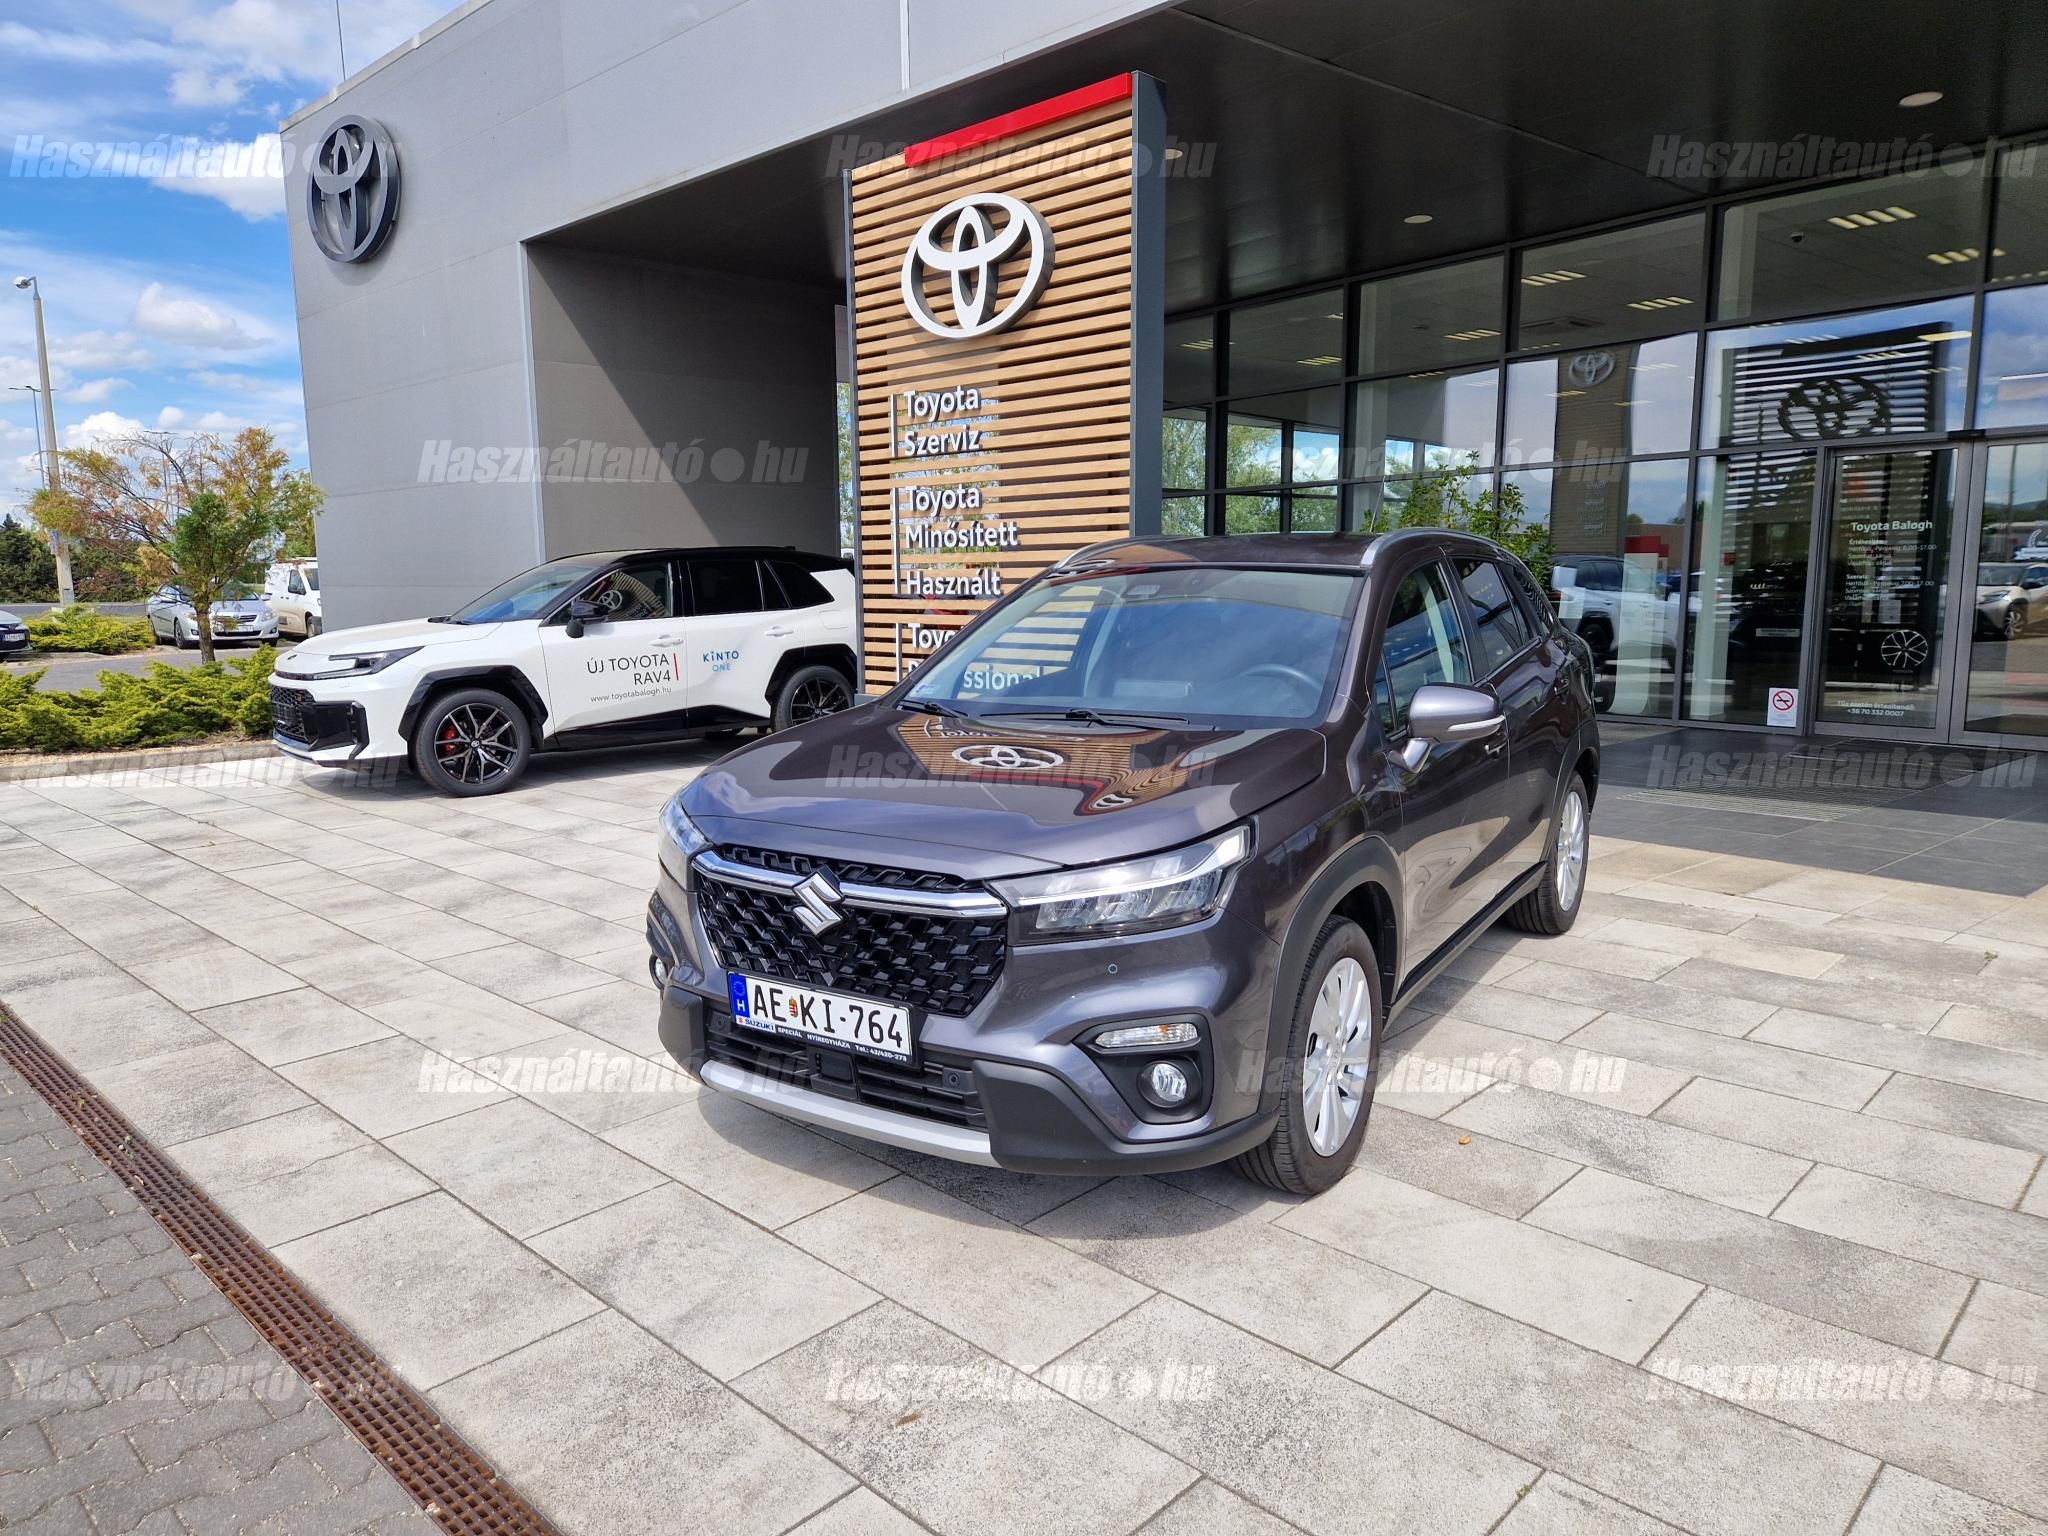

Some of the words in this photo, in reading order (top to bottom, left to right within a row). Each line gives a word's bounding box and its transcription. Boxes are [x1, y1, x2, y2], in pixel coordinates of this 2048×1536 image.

[904, 385, 981, 422] Toyota
[905, 424, 981, 455] Szerviz
[904, 484, 981, 517] Toyota
[906, 520, 1018, 548] Minősített
[1850, 522, 1889, 532] Toyota
[1892, 520, 1933, 531] Balogh
[906, 568, 1001, 596] Használt
[587, 657, 604, 674] ÚJ
[608, 653, 670, 671] TOYOTA
[712, 663, 731, 672] ONE
[634, 670, 671, 686] RAV4
[591, 687, 672, 703] www.toyotabalogh.hu
[737, 999, 746, 1013] H
[753, 984, 787, 1023] AE
[799, 994, 903, 1049] KI-764
[745, 1018, 775, 1031] SUZUKI
[778, 1027, 803, 1038] SPECIÁL
[807, 1033, 851, 1049] NYÍREGYHÁZA
